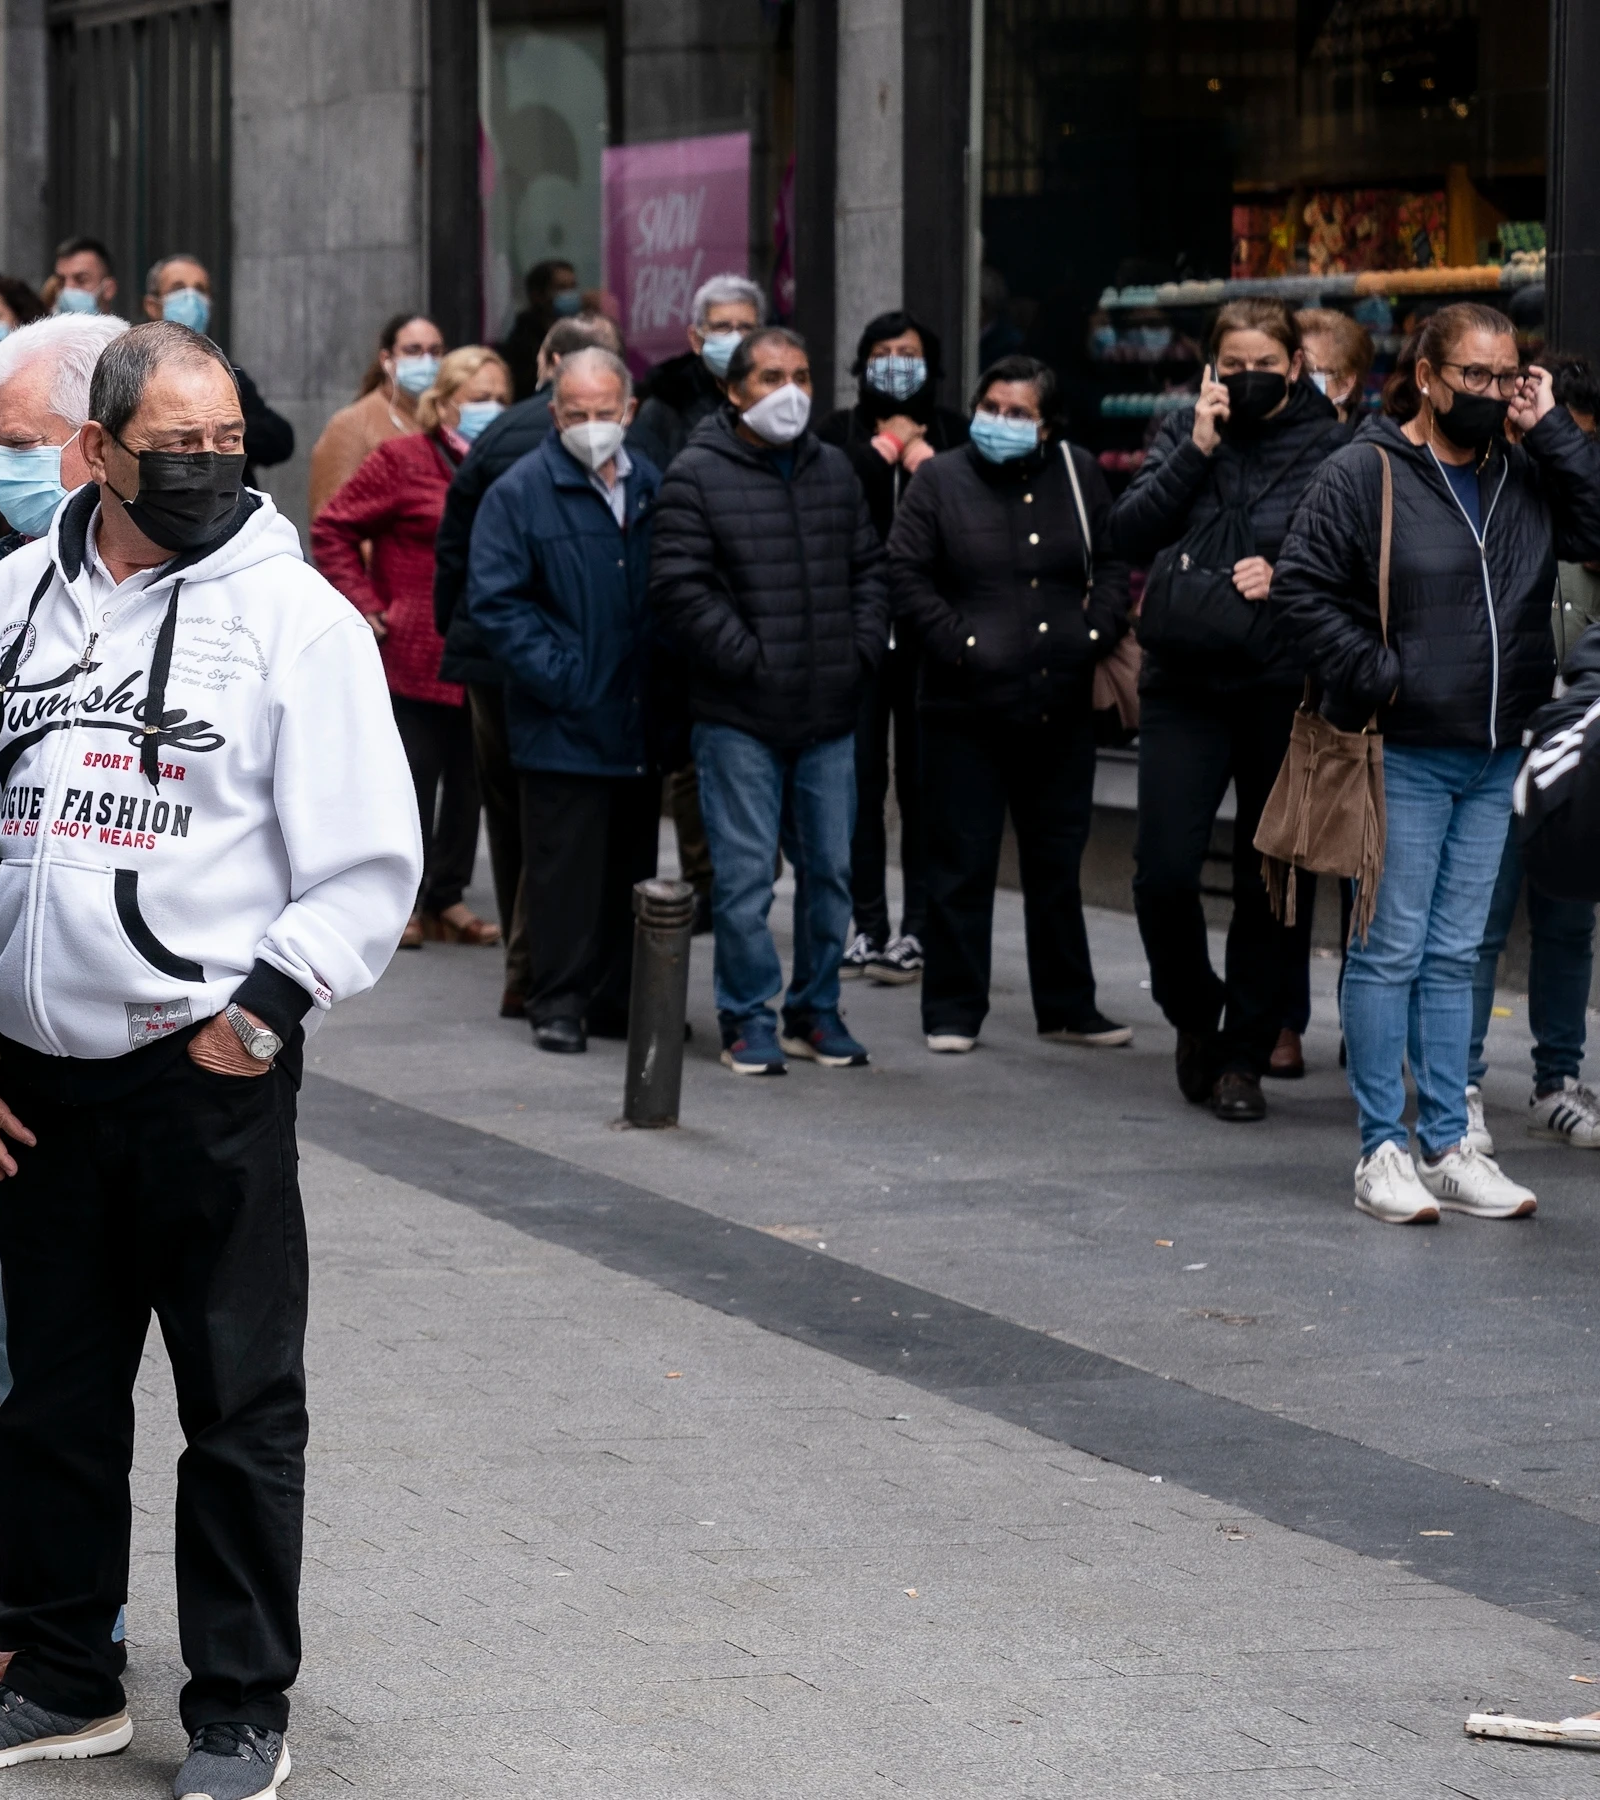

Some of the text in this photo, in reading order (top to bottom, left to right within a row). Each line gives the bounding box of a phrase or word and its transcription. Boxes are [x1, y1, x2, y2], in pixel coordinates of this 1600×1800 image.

[83, 751, 133, 771] SPORT
[59, 787, 193, 838] FASHION
[1, 820, 22, 836] NEW
[51, 820, 92, 839] SHOY
[99, 827, 157, 850] WEARS
